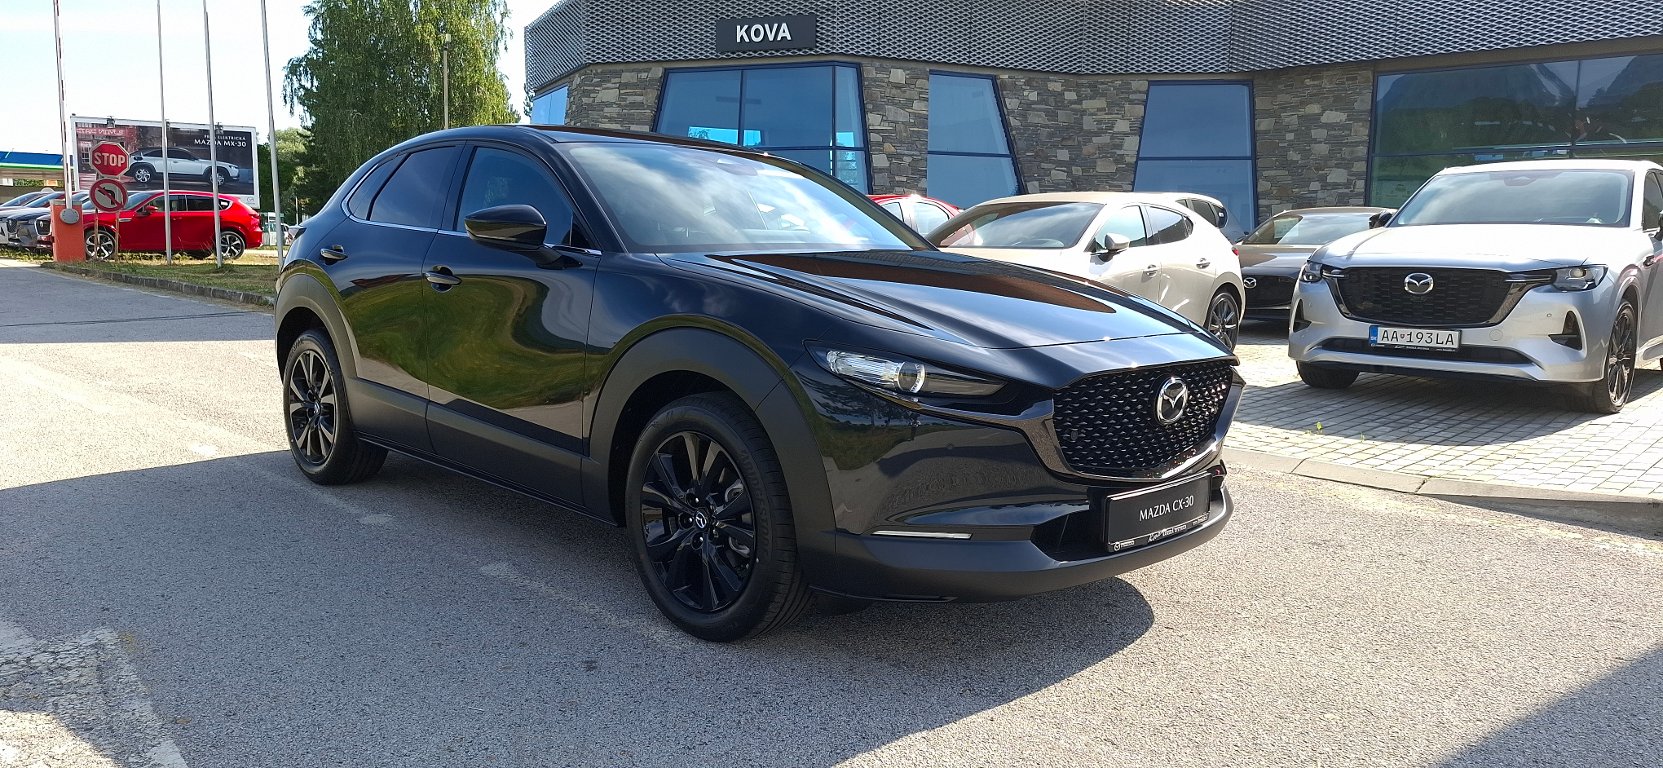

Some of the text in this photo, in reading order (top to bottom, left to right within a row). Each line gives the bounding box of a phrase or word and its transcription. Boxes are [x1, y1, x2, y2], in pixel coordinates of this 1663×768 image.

[736, 22, 792, 43] KOVA
[94, 152, 126, 167] STOP
[1139, 495, 1194, 521] MAZDA CX-30
